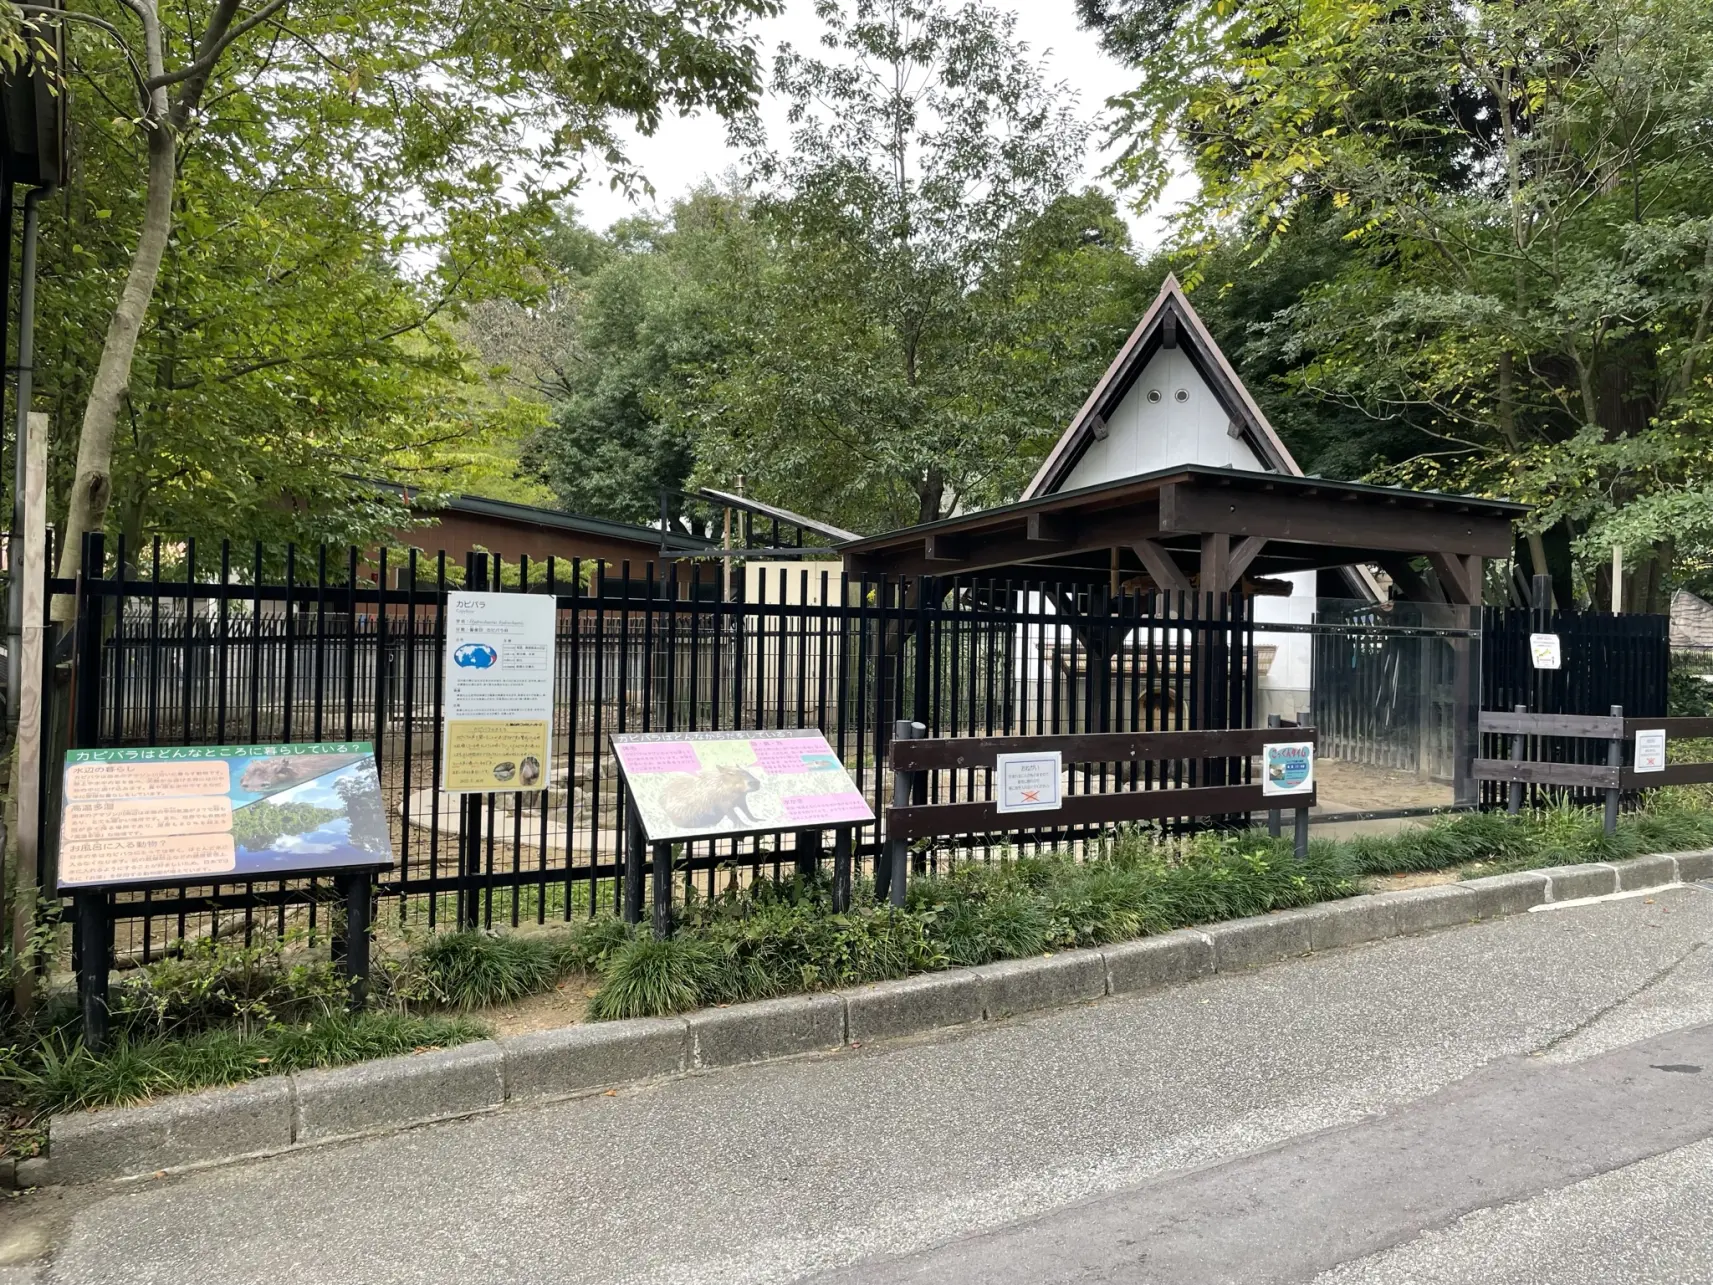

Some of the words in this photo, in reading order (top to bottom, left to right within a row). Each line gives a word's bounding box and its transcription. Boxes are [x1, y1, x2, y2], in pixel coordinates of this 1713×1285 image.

[76, 744, 360, 761] カピバラはどんなところに暮らしている？
